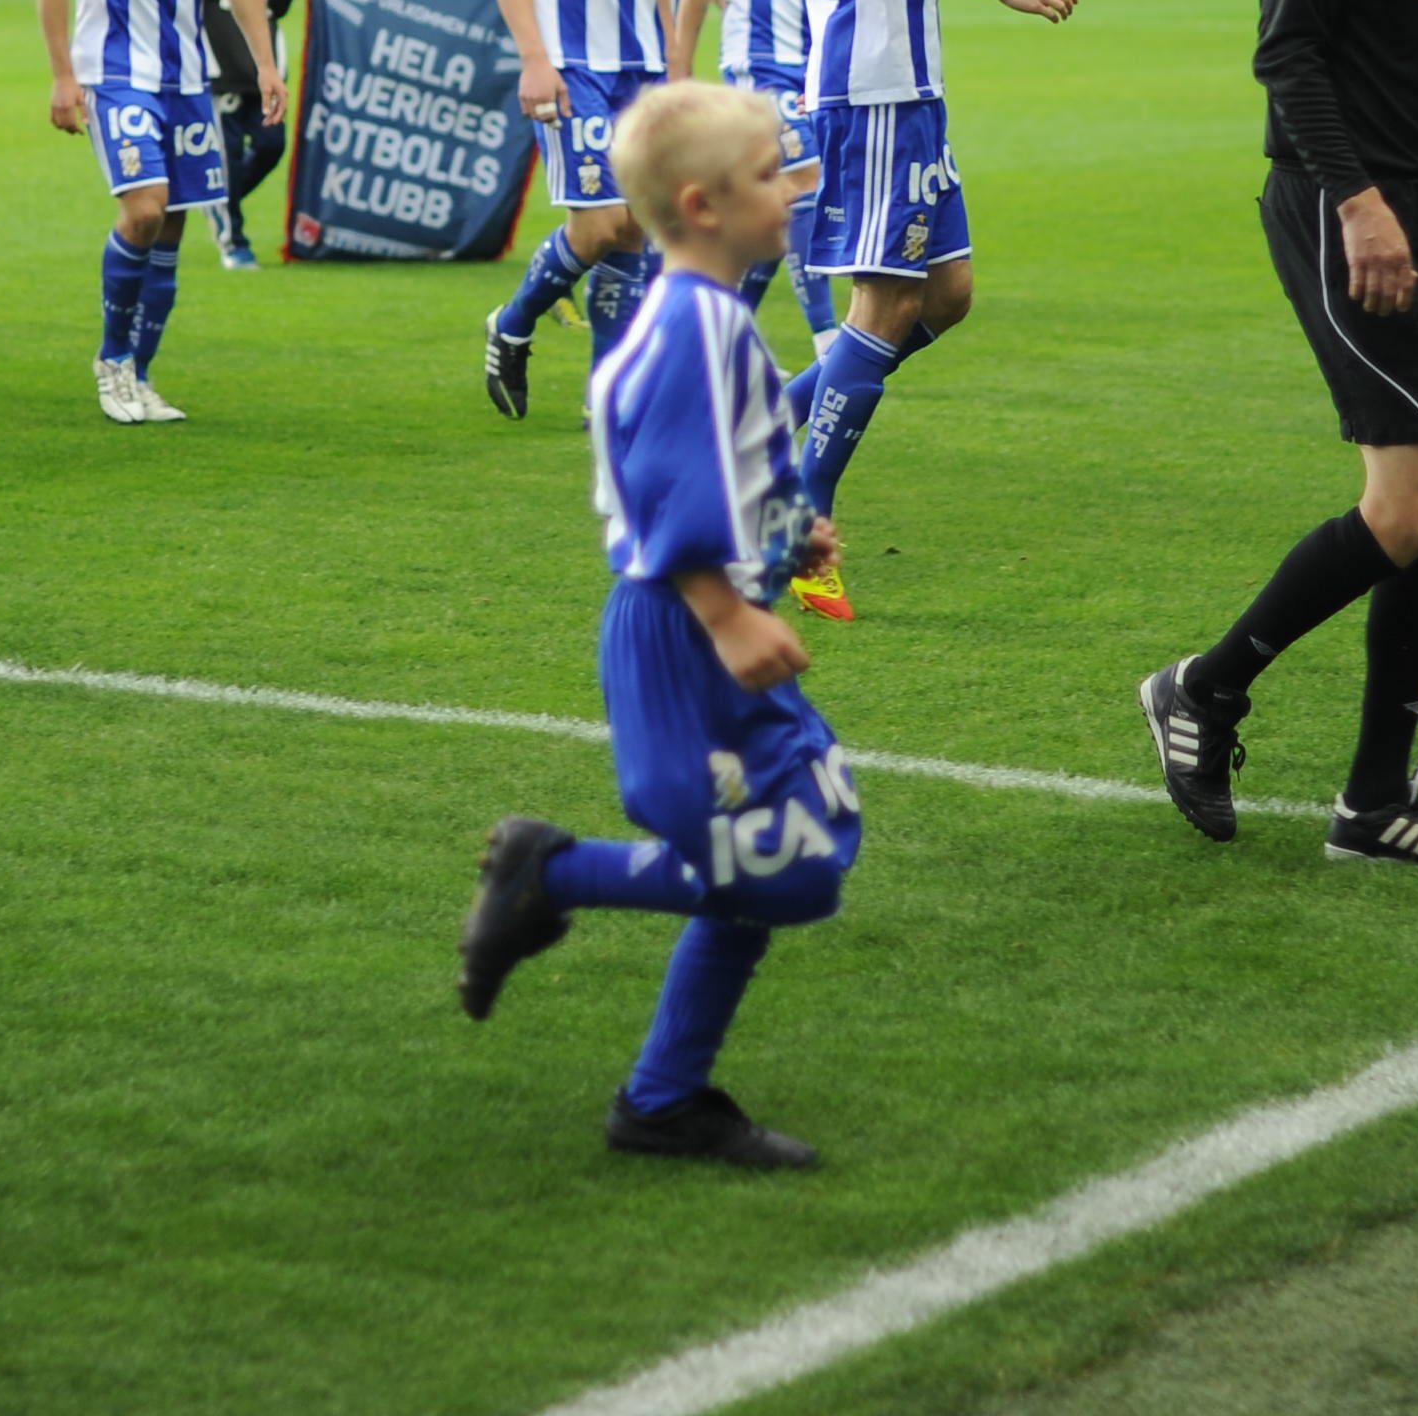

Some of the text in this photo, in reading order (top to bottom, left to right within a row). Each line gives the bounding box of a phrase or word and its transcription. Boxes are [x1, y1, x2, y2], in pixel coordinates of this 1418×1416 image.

[371, 28, 476, 95] HELA
[322, 62, 508, 150] SVERIGES
[571, 116, 615, 153] IC
[305, 102, 500, 197] FOTBOLLS
[321, 162, 453, 229] KLUBB
[810, 385, 849, 459] SKF
[710, 797, 837, 886] ICA
